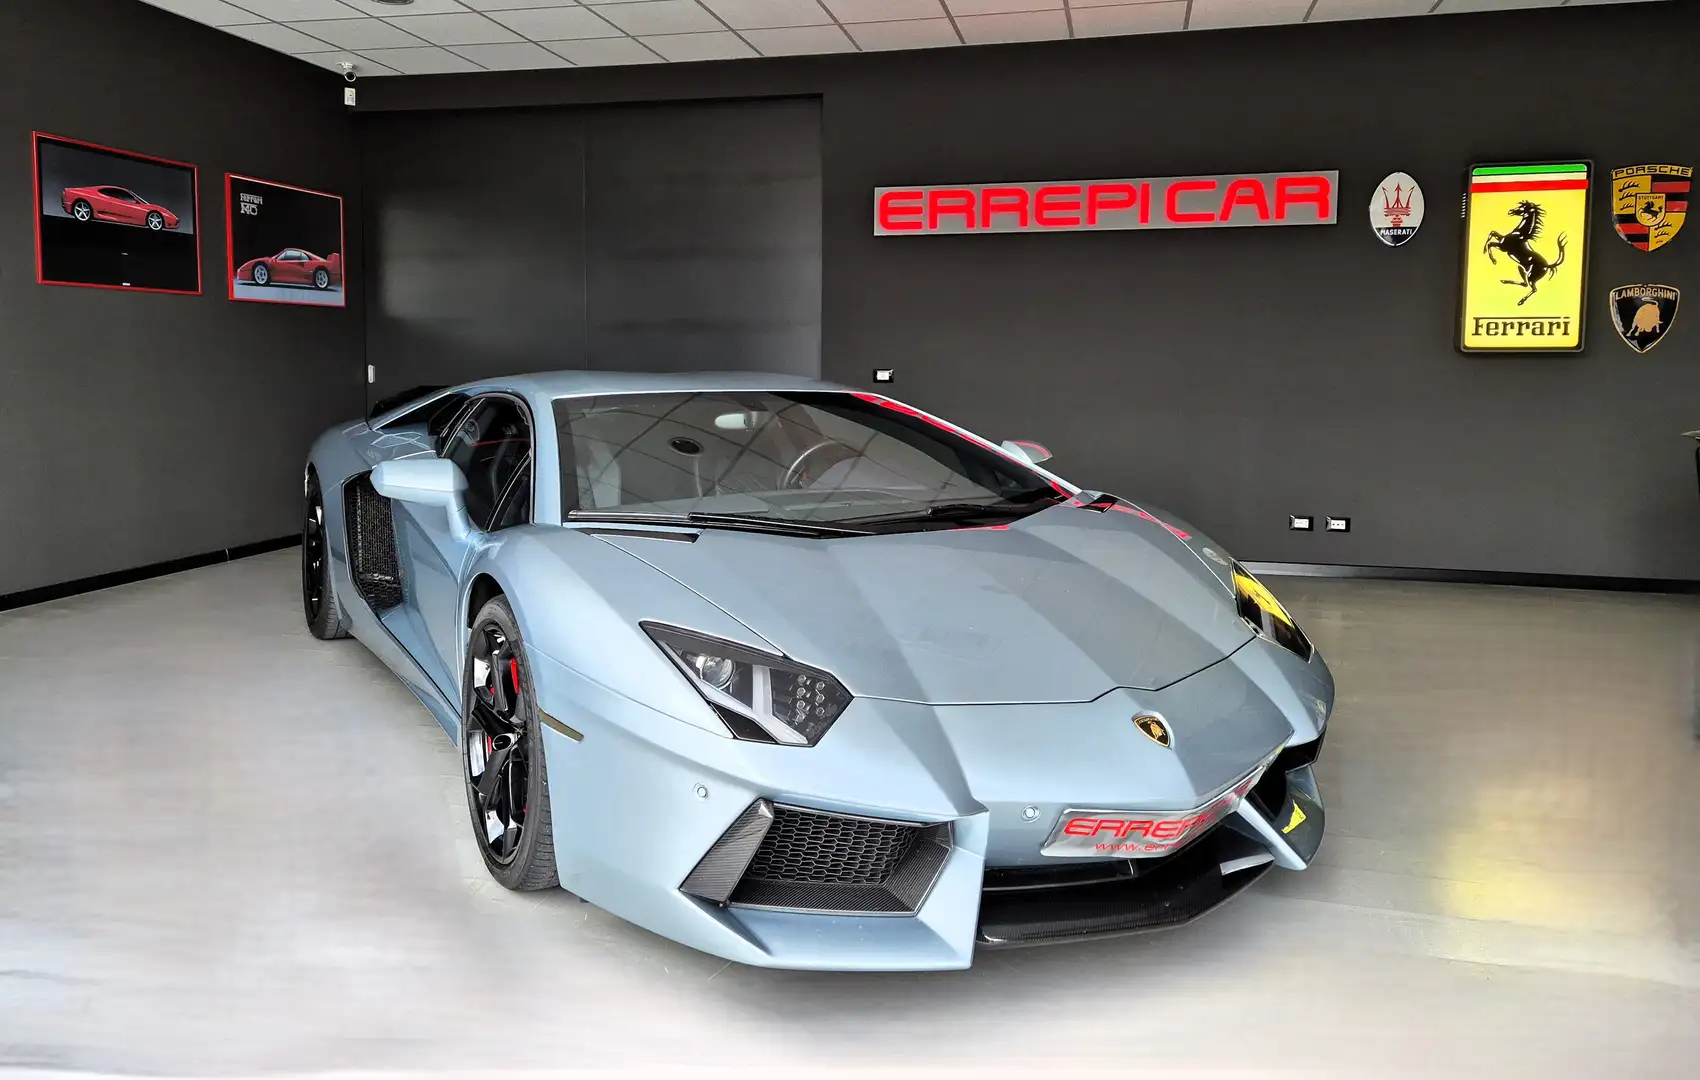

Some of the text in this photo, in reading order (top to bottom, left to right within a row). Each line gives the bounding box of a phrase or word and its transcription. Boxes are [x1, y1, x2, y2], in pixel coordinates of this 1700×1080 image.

[1614, 165, 1690, 177] PORSCHE
[1165, 175, 1331, 223] CAR
[1379, 228, 1413, 236] MASERATI
[1615, 287, 1677, 300] LAMBORGHINI
[1471, 316, 1571, 337] Ferrari
